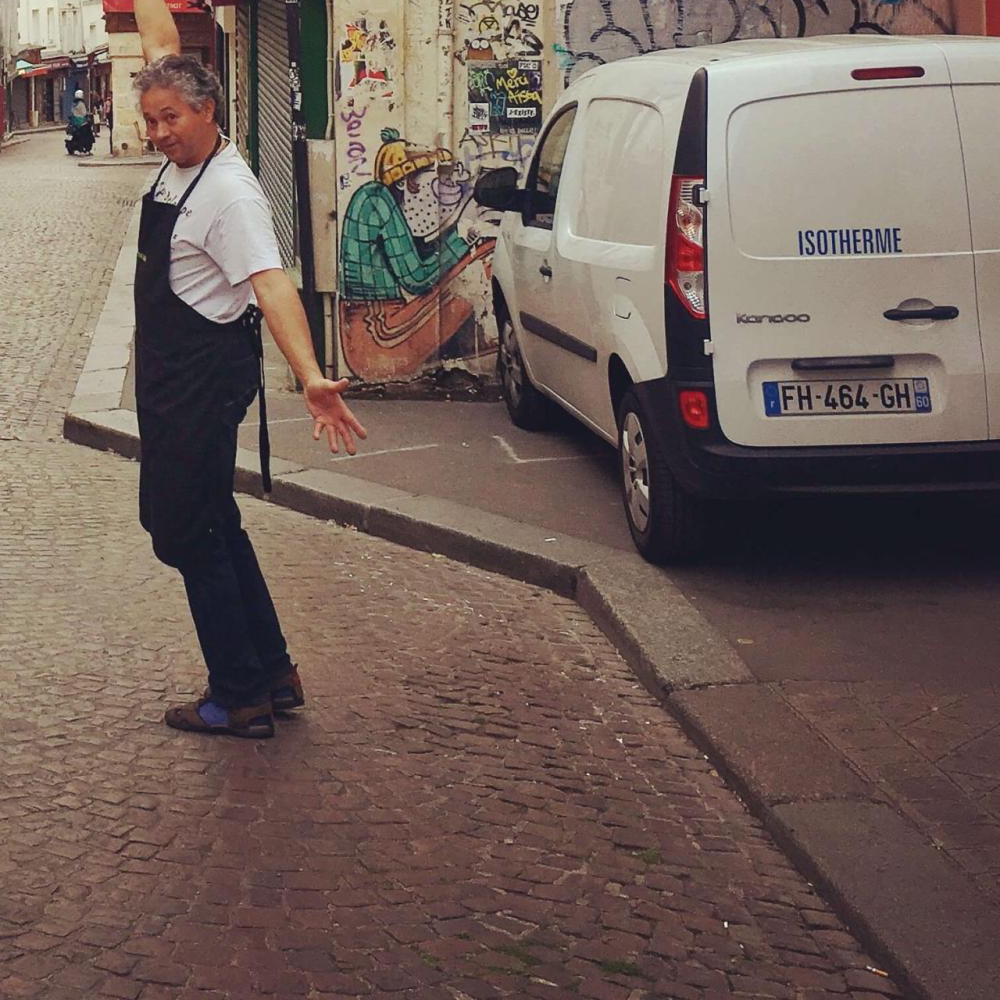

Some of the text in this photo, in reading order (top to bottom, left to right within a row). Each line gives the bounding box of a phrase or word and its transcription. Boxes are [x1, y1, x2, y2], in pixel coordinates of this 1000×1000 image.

[797, 227, 903, 256] ISOTHERME
[780, 382, 912, 412] FH-464-GH
[915, 395, 930, 408] 60
